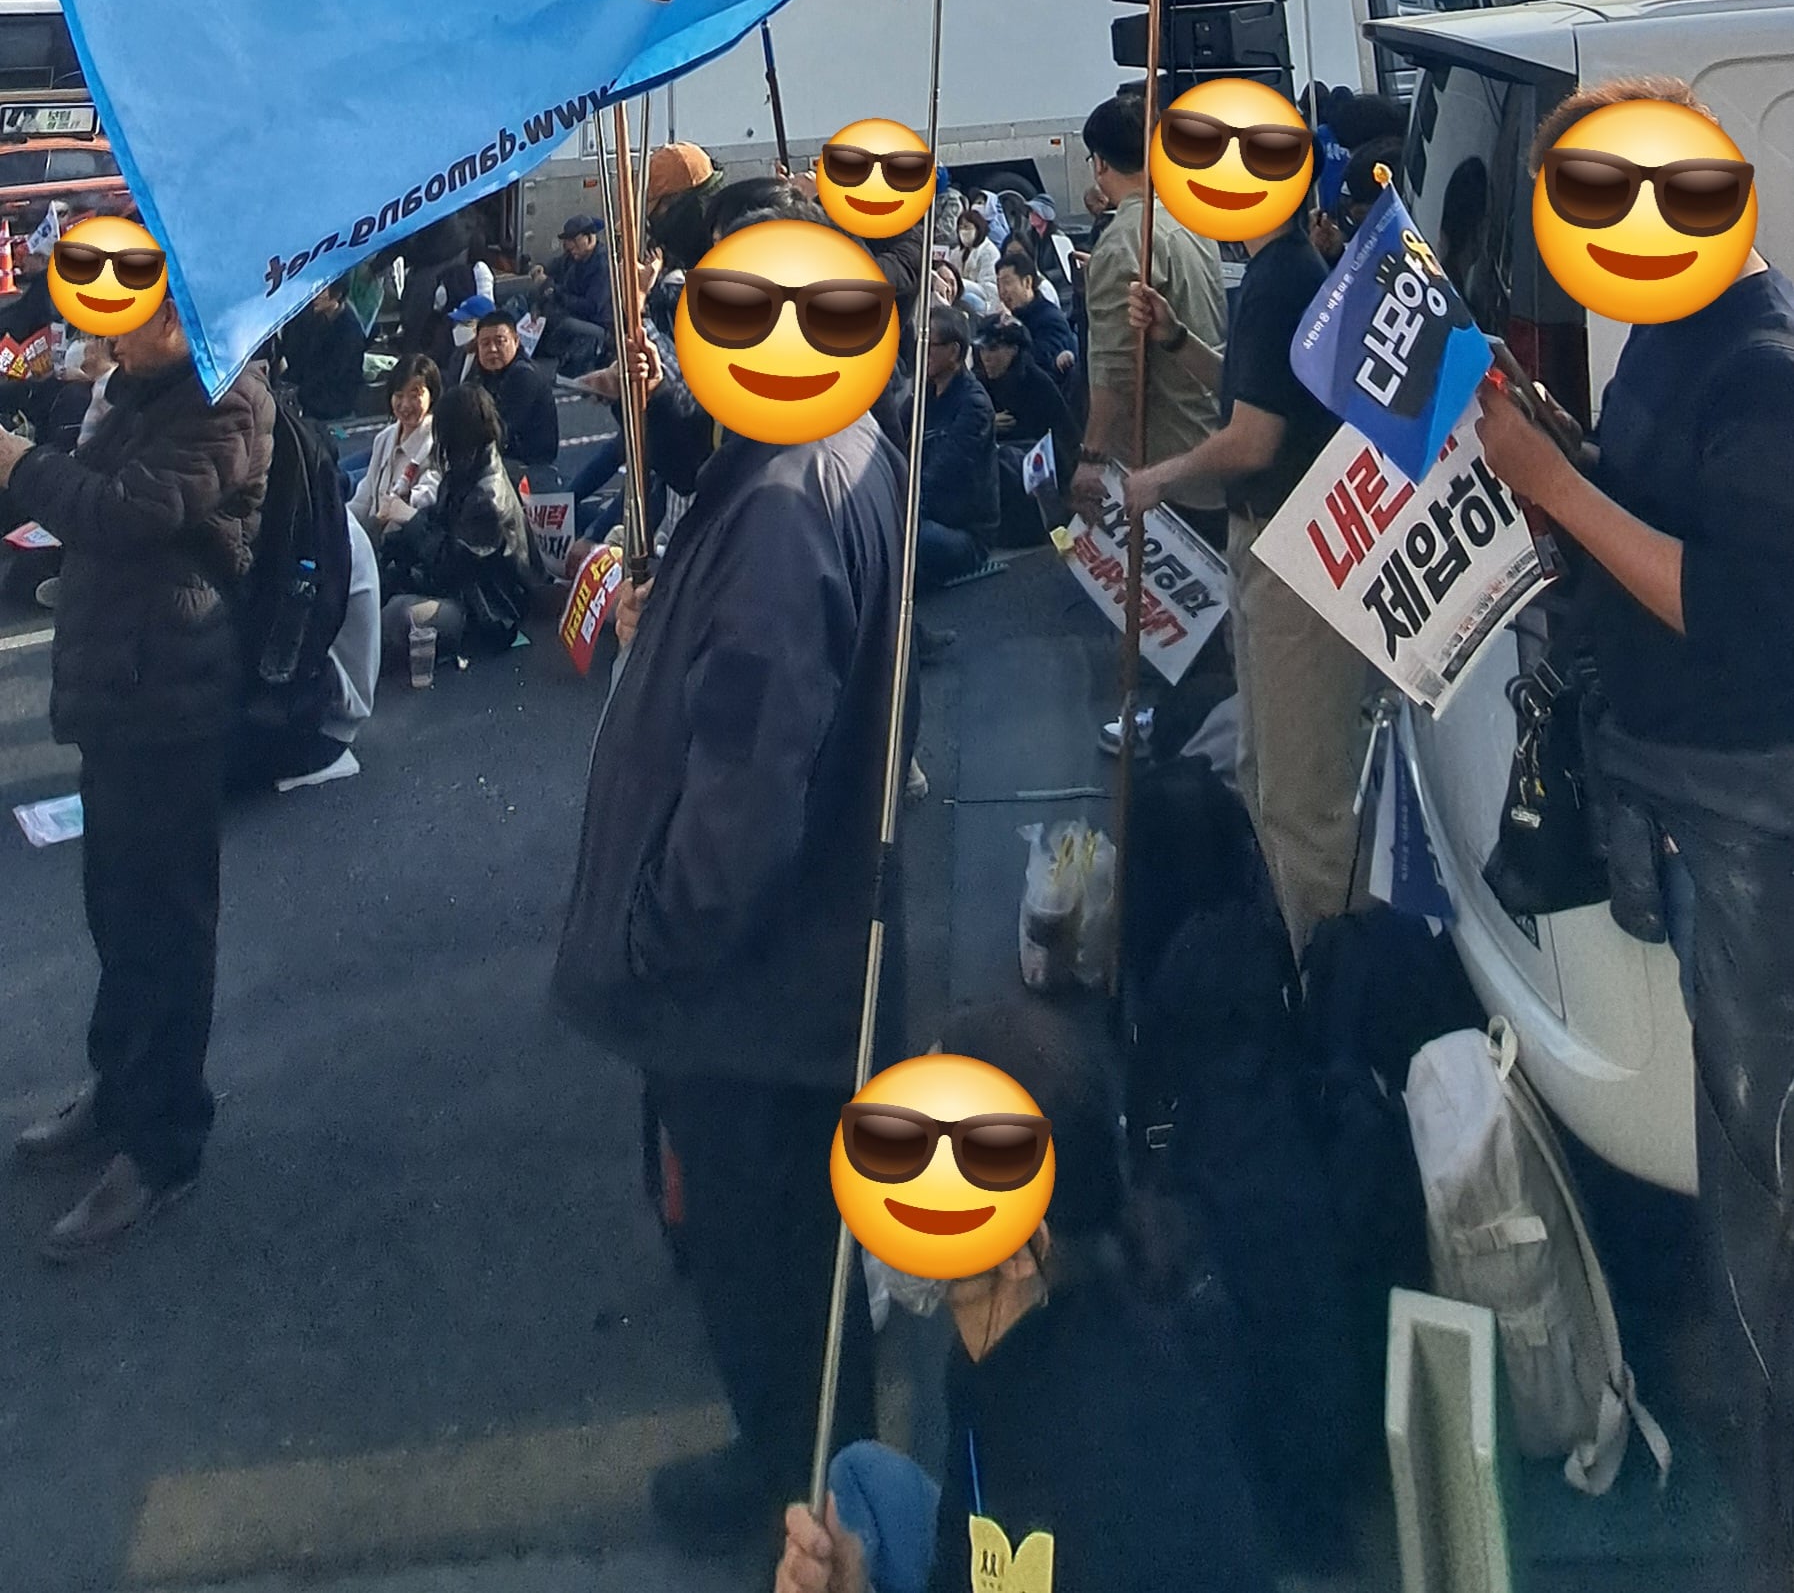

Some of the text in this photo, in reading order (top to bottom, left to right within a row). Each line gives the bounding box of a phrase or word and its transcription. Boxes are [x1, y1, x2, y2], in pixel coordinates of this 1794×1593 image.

[1355, 252, 1448, 407] 다모앙
[526, 503, 569, 530] 세력
[1307, 435, 1457, 590] 내란
[1361, 456, 1519, 662] 제압하
